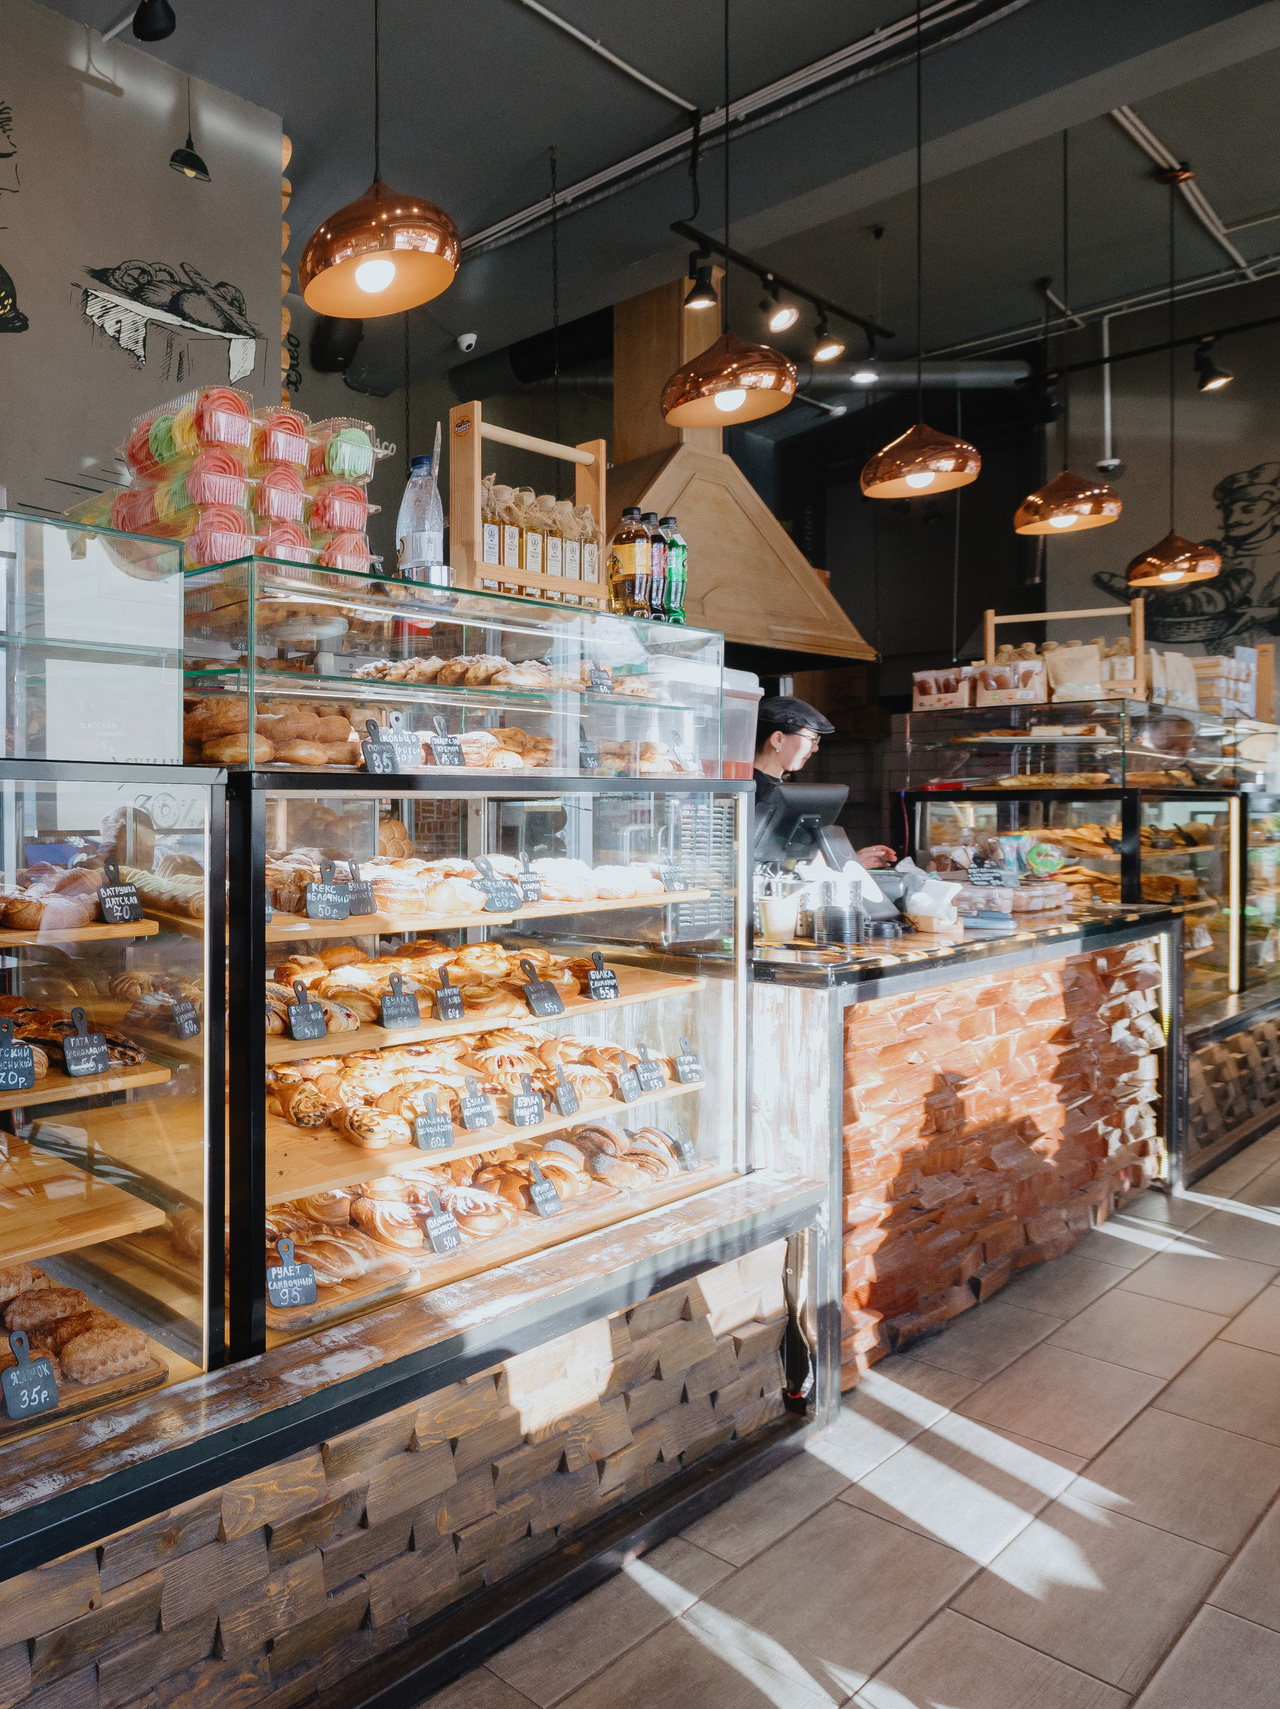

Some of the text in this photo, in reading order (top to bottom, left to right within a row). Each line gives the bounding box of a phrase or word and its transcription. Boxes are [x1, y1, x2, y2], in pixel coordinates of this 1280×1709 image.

[372, 752, 393, 774] 35
[310, 882, 338, 894] КЕКС
[105, 895, 140, 909] ДАТСКАЯ
[113, 905, 131, 920] 70
[590, 969, 615, 980] БУЛКА
[70, 1035, 99, 1047] ГАТА С
[517, 1095, 540, 1108] БУЛКА
[272, 1265, 302, 1280] РУЛЕТ
[267, 1273, 314, 1291] СЛИВОЧНЫЙ
[279, 1286, 303, 1306] 95
